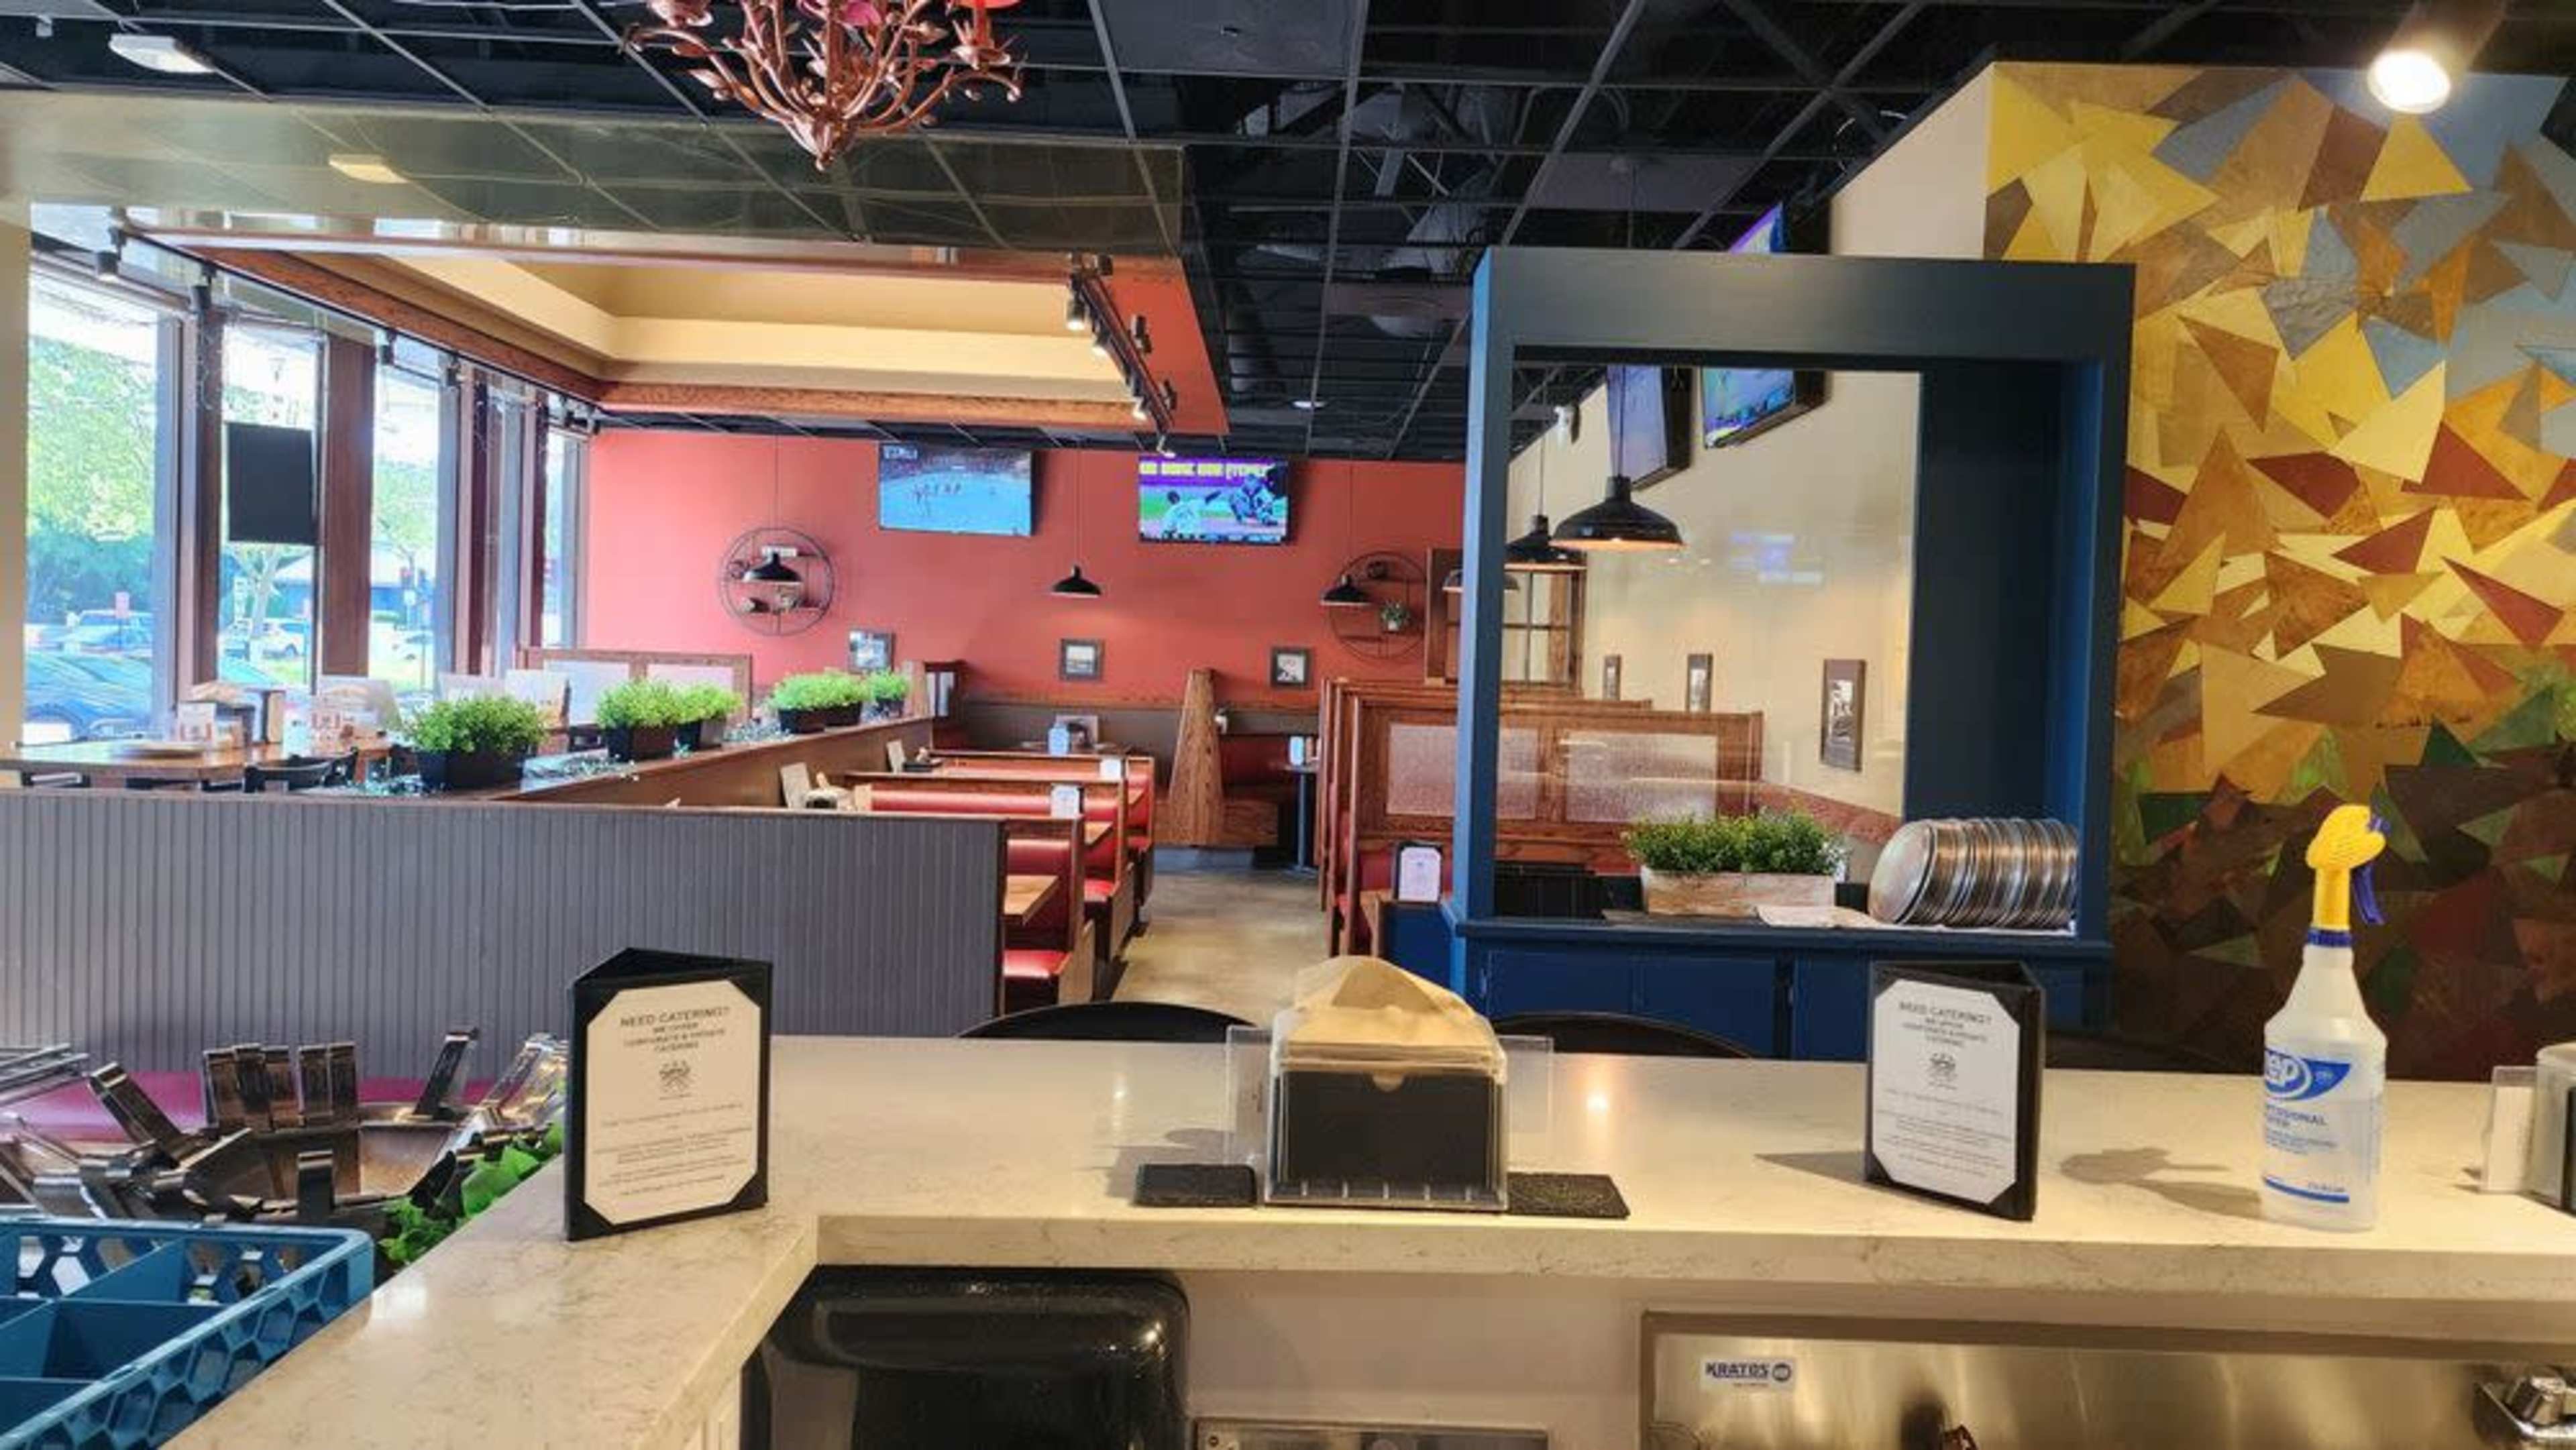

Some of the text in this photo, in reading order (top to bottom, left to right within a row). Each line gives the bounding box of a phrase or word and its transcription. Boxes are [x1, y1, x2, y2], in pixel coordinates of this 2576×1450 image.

[620, 1006, 730, 1027] NEED CATERING?
[1705, 1361, 1770, 1378] KRATOS
